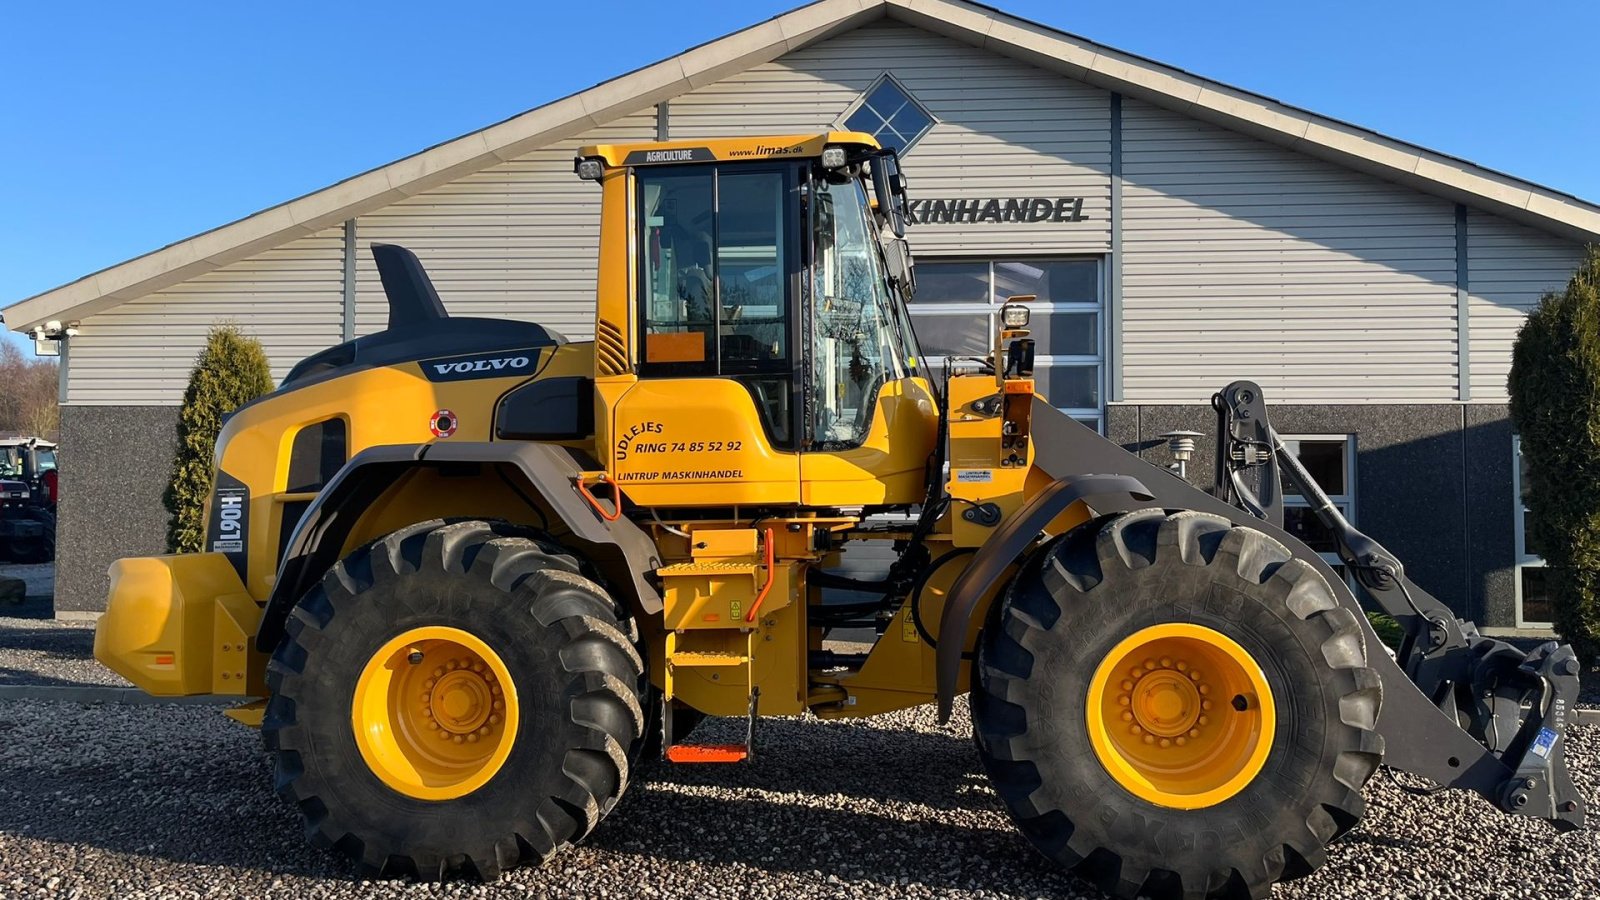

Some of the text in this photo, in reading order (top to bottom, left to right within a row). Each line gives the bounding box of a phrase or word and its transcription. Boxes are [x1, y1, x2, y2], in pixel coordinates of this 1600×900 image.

[646, 150, 693, 162] AGRICULTURE
[729, 145, 804, 157] www.limas.dk
[433, 356, 529, 375] VOLVO
[617, 422, 663, 460] UDLEJES
[635, 441, 742, 453] RING 74 85 52 92
[617, 469, 744, 481] LINTRUP MASKINHANDEL
[219, 496, 242, 540] L90H
